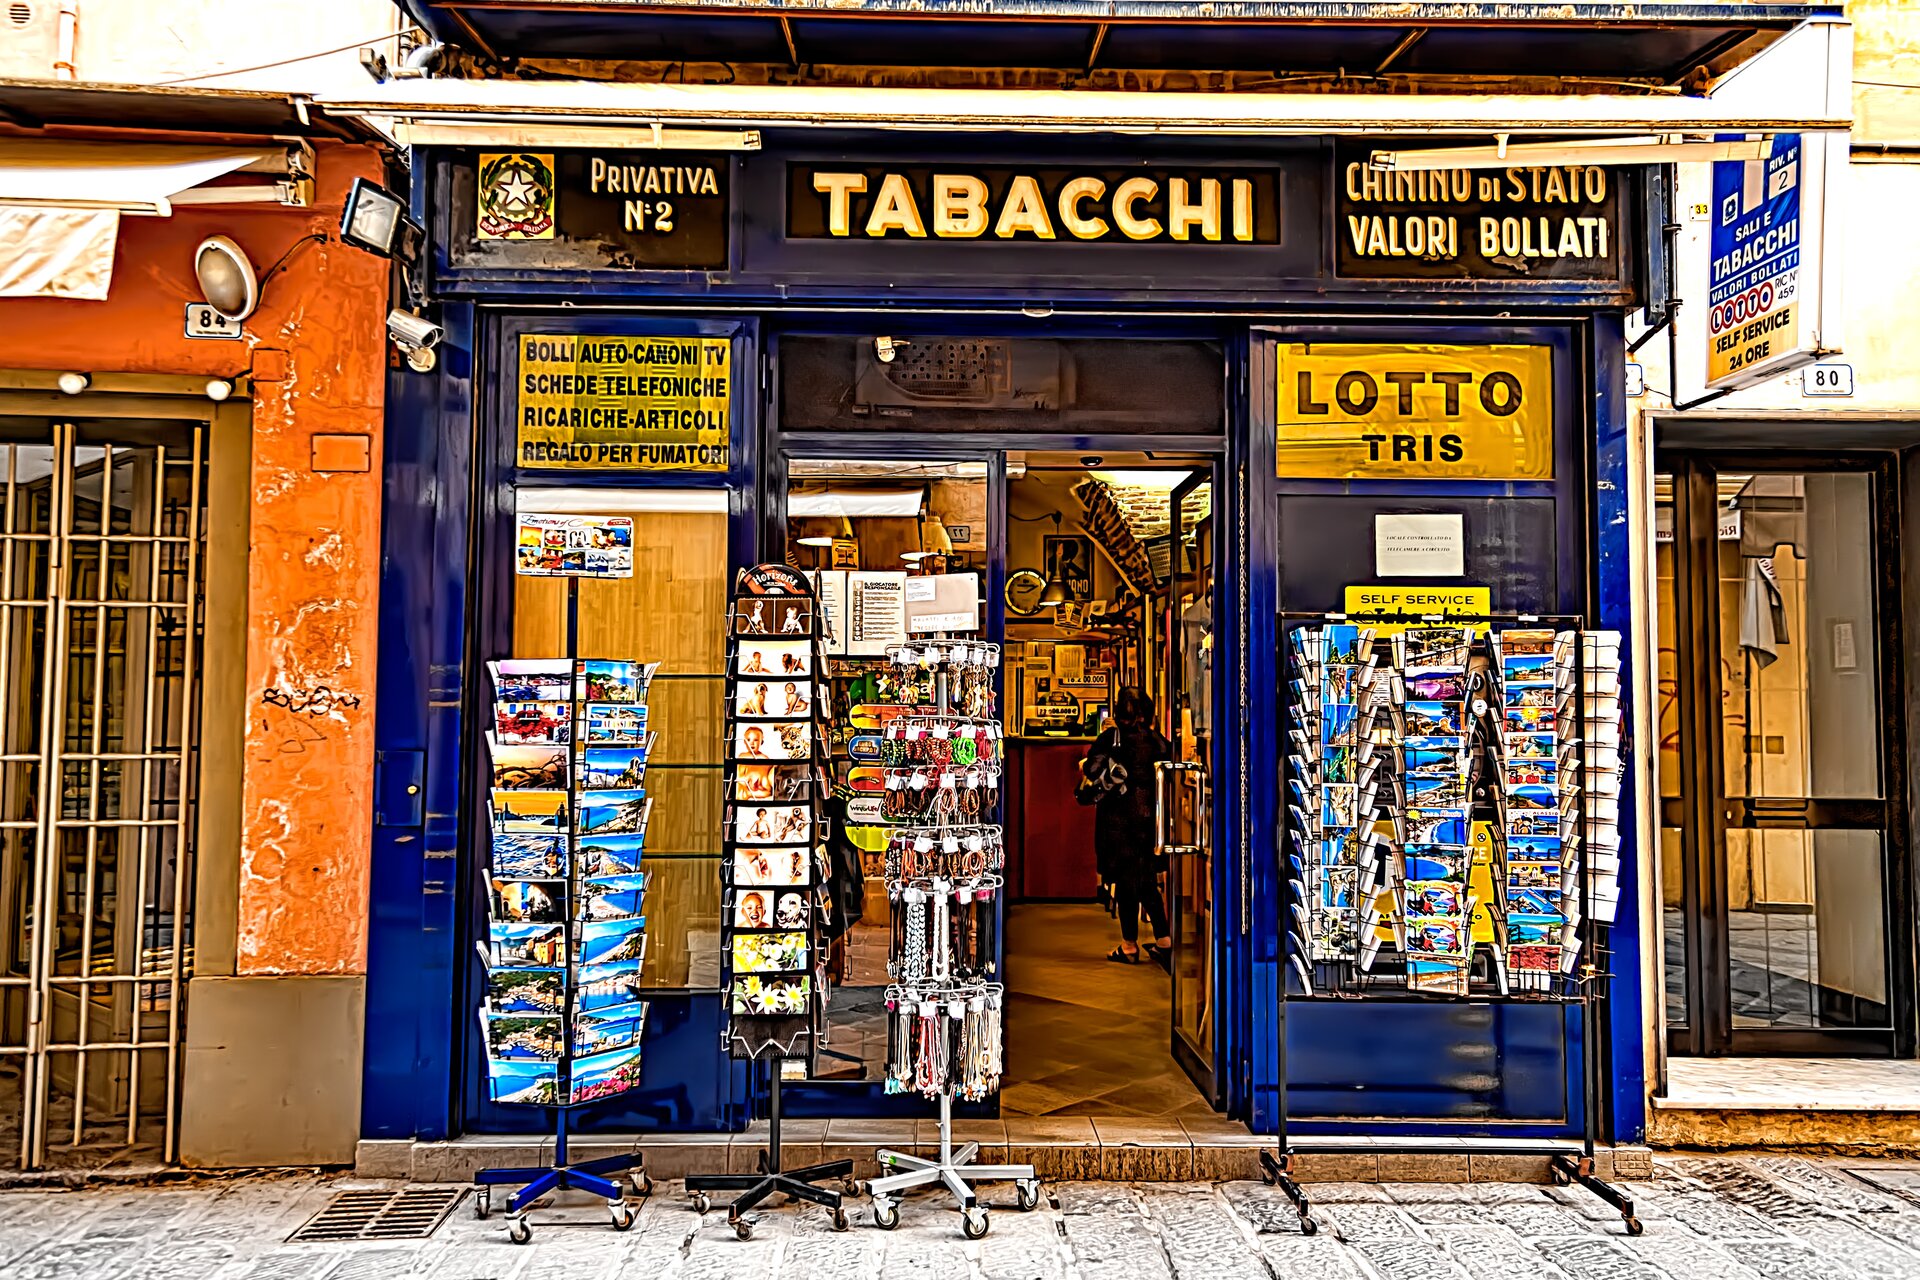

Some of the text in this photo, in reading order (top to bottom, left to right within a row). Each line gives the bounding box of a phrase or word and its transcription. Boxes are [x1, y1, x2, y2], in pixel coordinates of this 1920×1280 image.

[591, 157, 719, 195] PRIVATIVA
[1769, 155, 1786, 172] RIV.
[1346, 162, 1471, 202] CHININO
[1506, 165, 1606, 203] STATO
[1778, 170, 1789, 191] 2
[813, 172, 1254, 242] TABACCHI
[1348, 215, 1608, 258] VALORI BOLLATI
[1735, 210, 1772, 242] SALI E
[1713, 218, 1797, 282] TABACCHI
[1711, 251, 1798, 304] VALORI BOLLATI
[1774, 275, 1788, 290] RIC
[1777, 285, 1795, 300] 459
[200, 310, 227, 328] 84
[1712, 284, 1771, 332] LOTTO
[1716, 308, 1790, 354] SELF SERVICE
[526, 342, 726, 366] BOLLI AUTO-CANONI TV
[1729, 341, 1770, 371] 24 ORE
[525, 374, 727, 398] SCHEDE TELEFONICHE
[1815, 370, 1839, 386] 80
[1297, 370, 1523, 417] LOTTO
[524, 406, 724, 430] RICARICHE-ARTICOLI
[523, 441, 729, 465] REGALO PER FUMATORI
[1361, 434, 1464, 462] TRIS
[1360, 594, 1475, 605] SELF SERVICE
